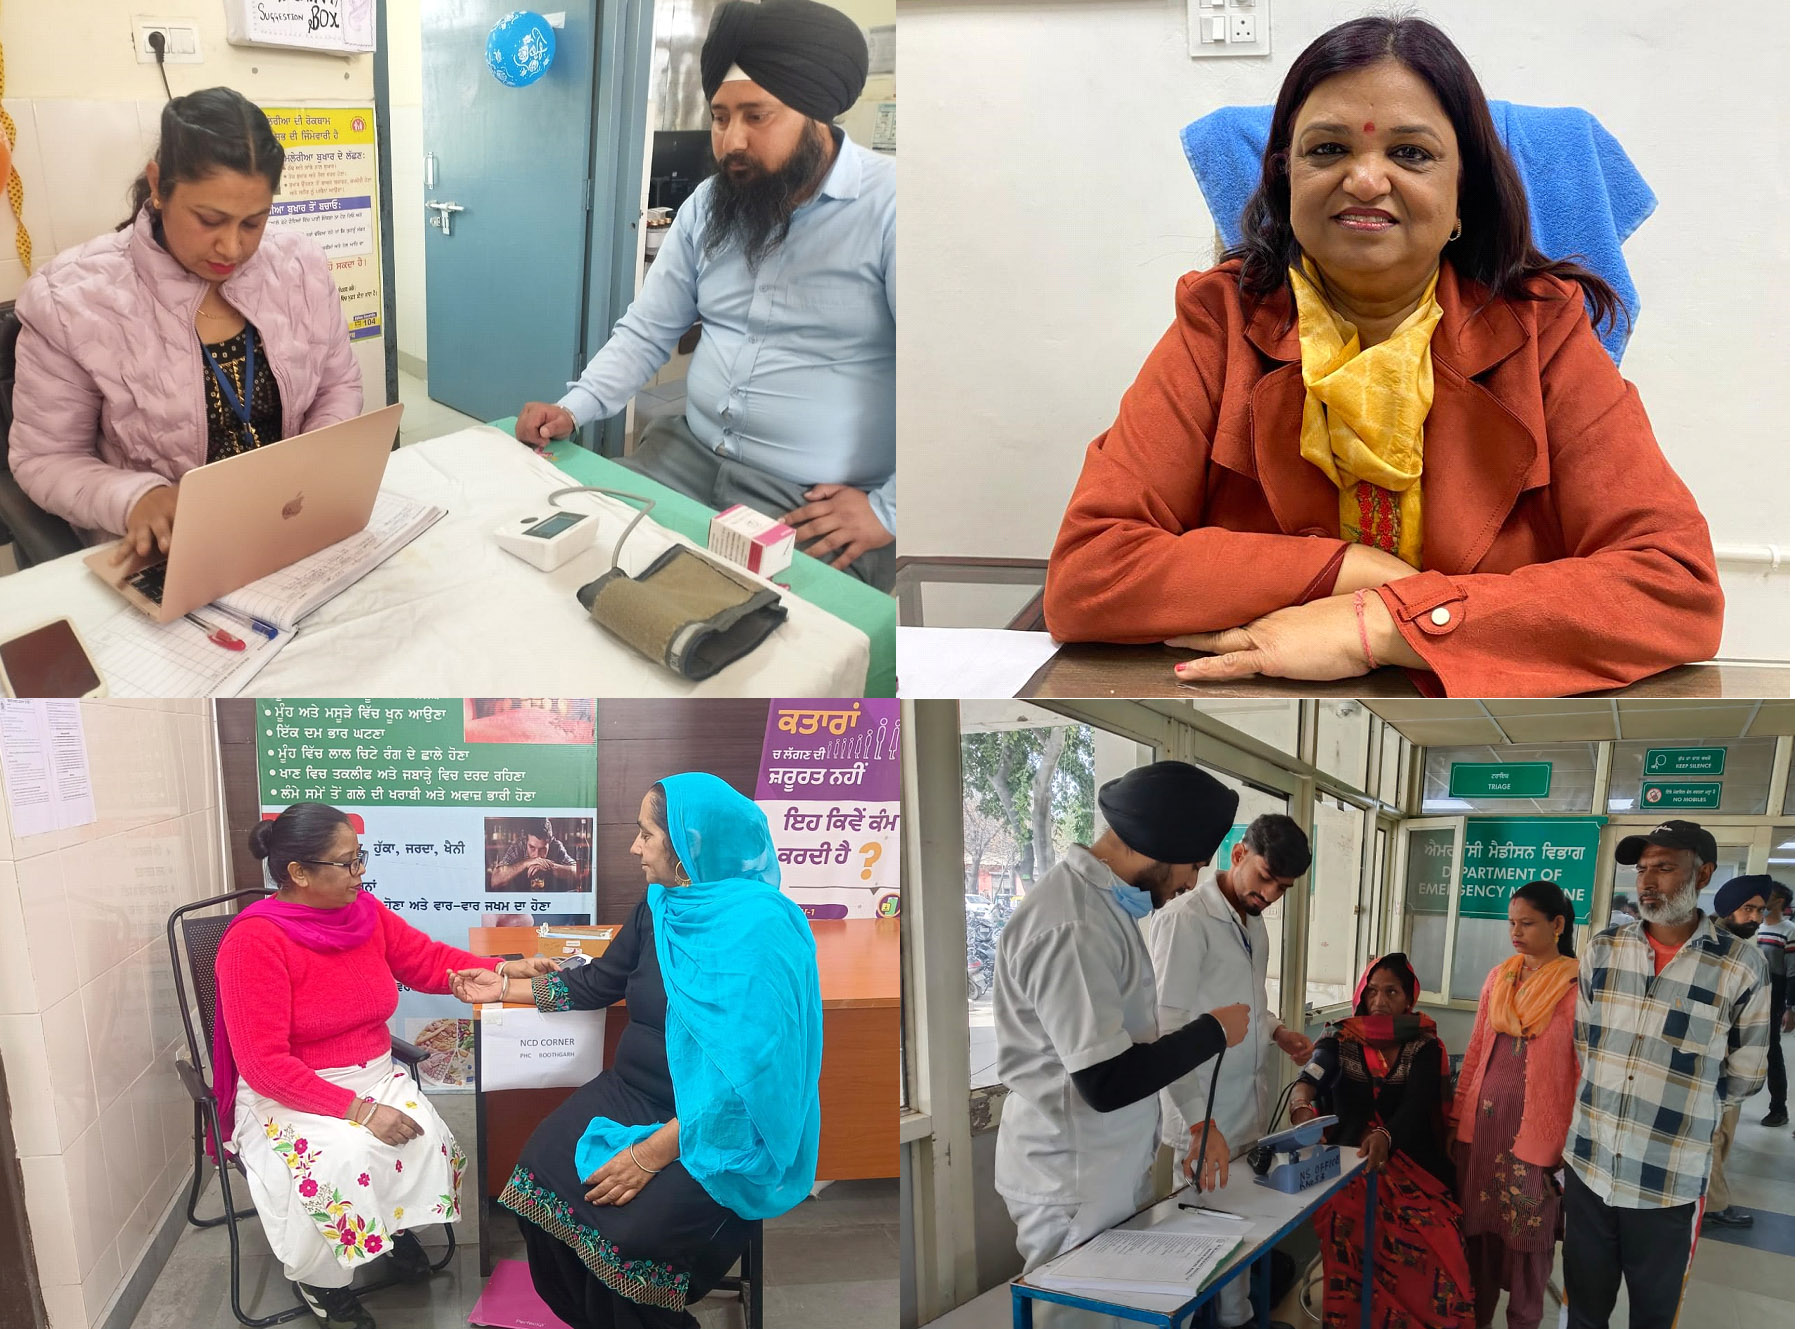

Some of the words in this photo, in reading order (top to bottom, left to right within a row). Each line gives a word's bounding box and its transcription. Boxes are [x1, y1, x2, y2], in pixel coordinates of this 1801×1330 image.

[294, 115, 302, 125] ਦੀ
[290, 131, 298, 140] ਦੀ
[333, 129, 338, 140] ਹੈ
[316, 153, 334, 163] ਬੁਖਾਰ
[337, 150, 342, 160] ਦੇ
[287, 204, 306, 215] ਬੁਖਾਰ
[336, 260, 355, 270] ਸਕਦਾ
[364, 318, 376, 326] 104
[275, 703, 294, 722] ਮੂੰਹ
[299, 704, 319, 718] ਅਤੇ
[325, 704, 352, 723] ਮਸੂੜੇ
[358, 704, 380, 719] ਵਿੱਚ
[385, 709, 403, 724] ਖੂਨ
[408, 706, 446, 722] ਆਉਣਾ
[778, 702, 861, 735] ਕਤਾਰਾਂ
[276, 724, 299, 738] ਇੱਕ
[304, 728, 322, 738] ਦਮ
[328, 728, 348, 739] ਭਾਰ
[353, 728, 385, 739] ਘਟਣਾ
[278, 744, 297, 763] ਮੂੰਹ
[301, 745, 324, 759] ਵਿੱਚ
[328, 749, 352, 759] ਲਾਲ
[356, 745, 378, 759] ਚਿਟੇ
[383, 746, 402, 760] ਰੰਗ
[406, 746, 416, 760] ਦੇ
[421, 747, 443, 760] ਛਾਲੇ
[448, 747, 470, 760] ਹੋਣਾ
[772, 750, 781, 760] ਚ
[783, 747, 812, 760] ਲੱਗਣ
[813, 747, 826, 760] ਦੀ
[279, 768, 301, 779] ਖਾਣ
[306, 765, 327, 779] ਵਿਚ
[332, 766, 372, 780] ਤਕਲੀਫ
[377, 766, 397, 780] ਅਤੇ
[438, 767, 459, 780] ਵਿਚ
[463, 770, 489, 781] ਦਰਦ
[494, 768, 526, 781] ਰਹਿਣਾ
[768, 767, 827, 792] ਜ਼ਰੂਰਤ
[829, 761, 869, 785] ਨਹੀਂ
[280, 785, 300, 799] ਲੰਮੇ
[305, 786, 326, 799] ਸਮੇਂ
[330, 785, 342, 799] ਤੋਂ
[346, 786, 366, 799] ਗਲੇ
[371, 786, 384, 799] ਦੀ
[389, 787, 421, 800] ਖਰਾਬੀ
[426, 787, 446, 800] ਅਤੇ
[450, 791, 482, 801] ਅਵਾਜ਼
[486, 788, 510, 801] ਭਾਰੀ
[515, 787, 536, 801] ਹੋਣਾ
[784, 806, 823, 832] ਇਹ
[826, 806, 866, 832] ਕਿਵੇਂ
[868, 808, 900, 832] ਕੰਮ
[374, 840, 400, 856] ਹੁੱਕਾ,
[405, 844, 438, 856] ਜਰਦਾ,
[444, 840, 465, 854] ਖੈਨੀ
[1488, 840, 1536, 860] ਮੈਡੀਸਨ
[1542, 842, 1586, 860] ਵਿਭਾਗ
[778, 841, 832, 865] ਕਰਦੀ
[834, 840, 852, 865] ਹੈ
[859, 841, 882, 880] ?
[1442, 866, 1536, 880] DPARTMENT
[1540, 869, 1563, 881] OF
[410, 898, 429, 911] ਅਤੇ
[485, 901, 510, 912] ਜਖਮ
[514, 901, 526, 911] ਦਾ
[531, 898, 551, 912] ਹੋਣਾ
